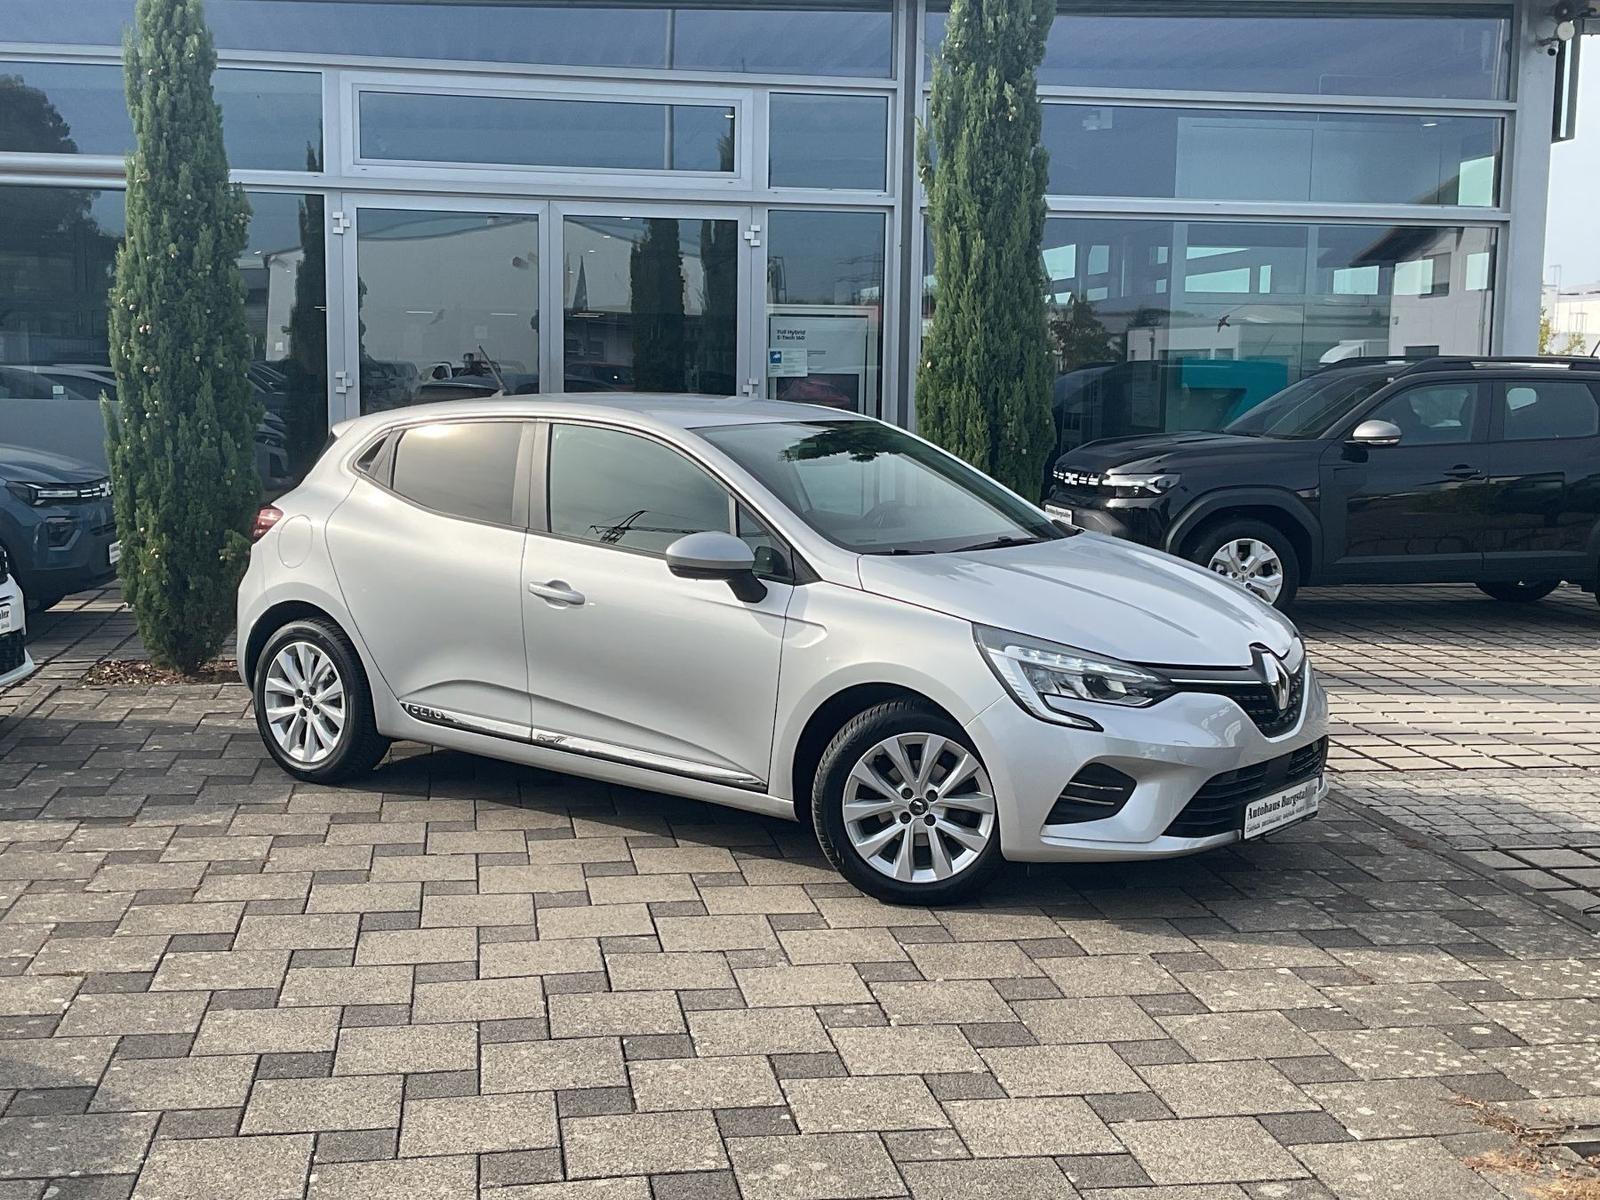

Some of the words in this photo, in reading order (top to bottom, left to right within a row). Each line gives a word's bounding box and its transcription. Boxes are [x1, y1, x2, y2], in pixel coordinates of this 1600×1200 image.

[411, 706, 442, 719] CLIO
[1248, 801, 1281, 820] Autohaus
[1282, 785, 1318, 807] Burgstar
